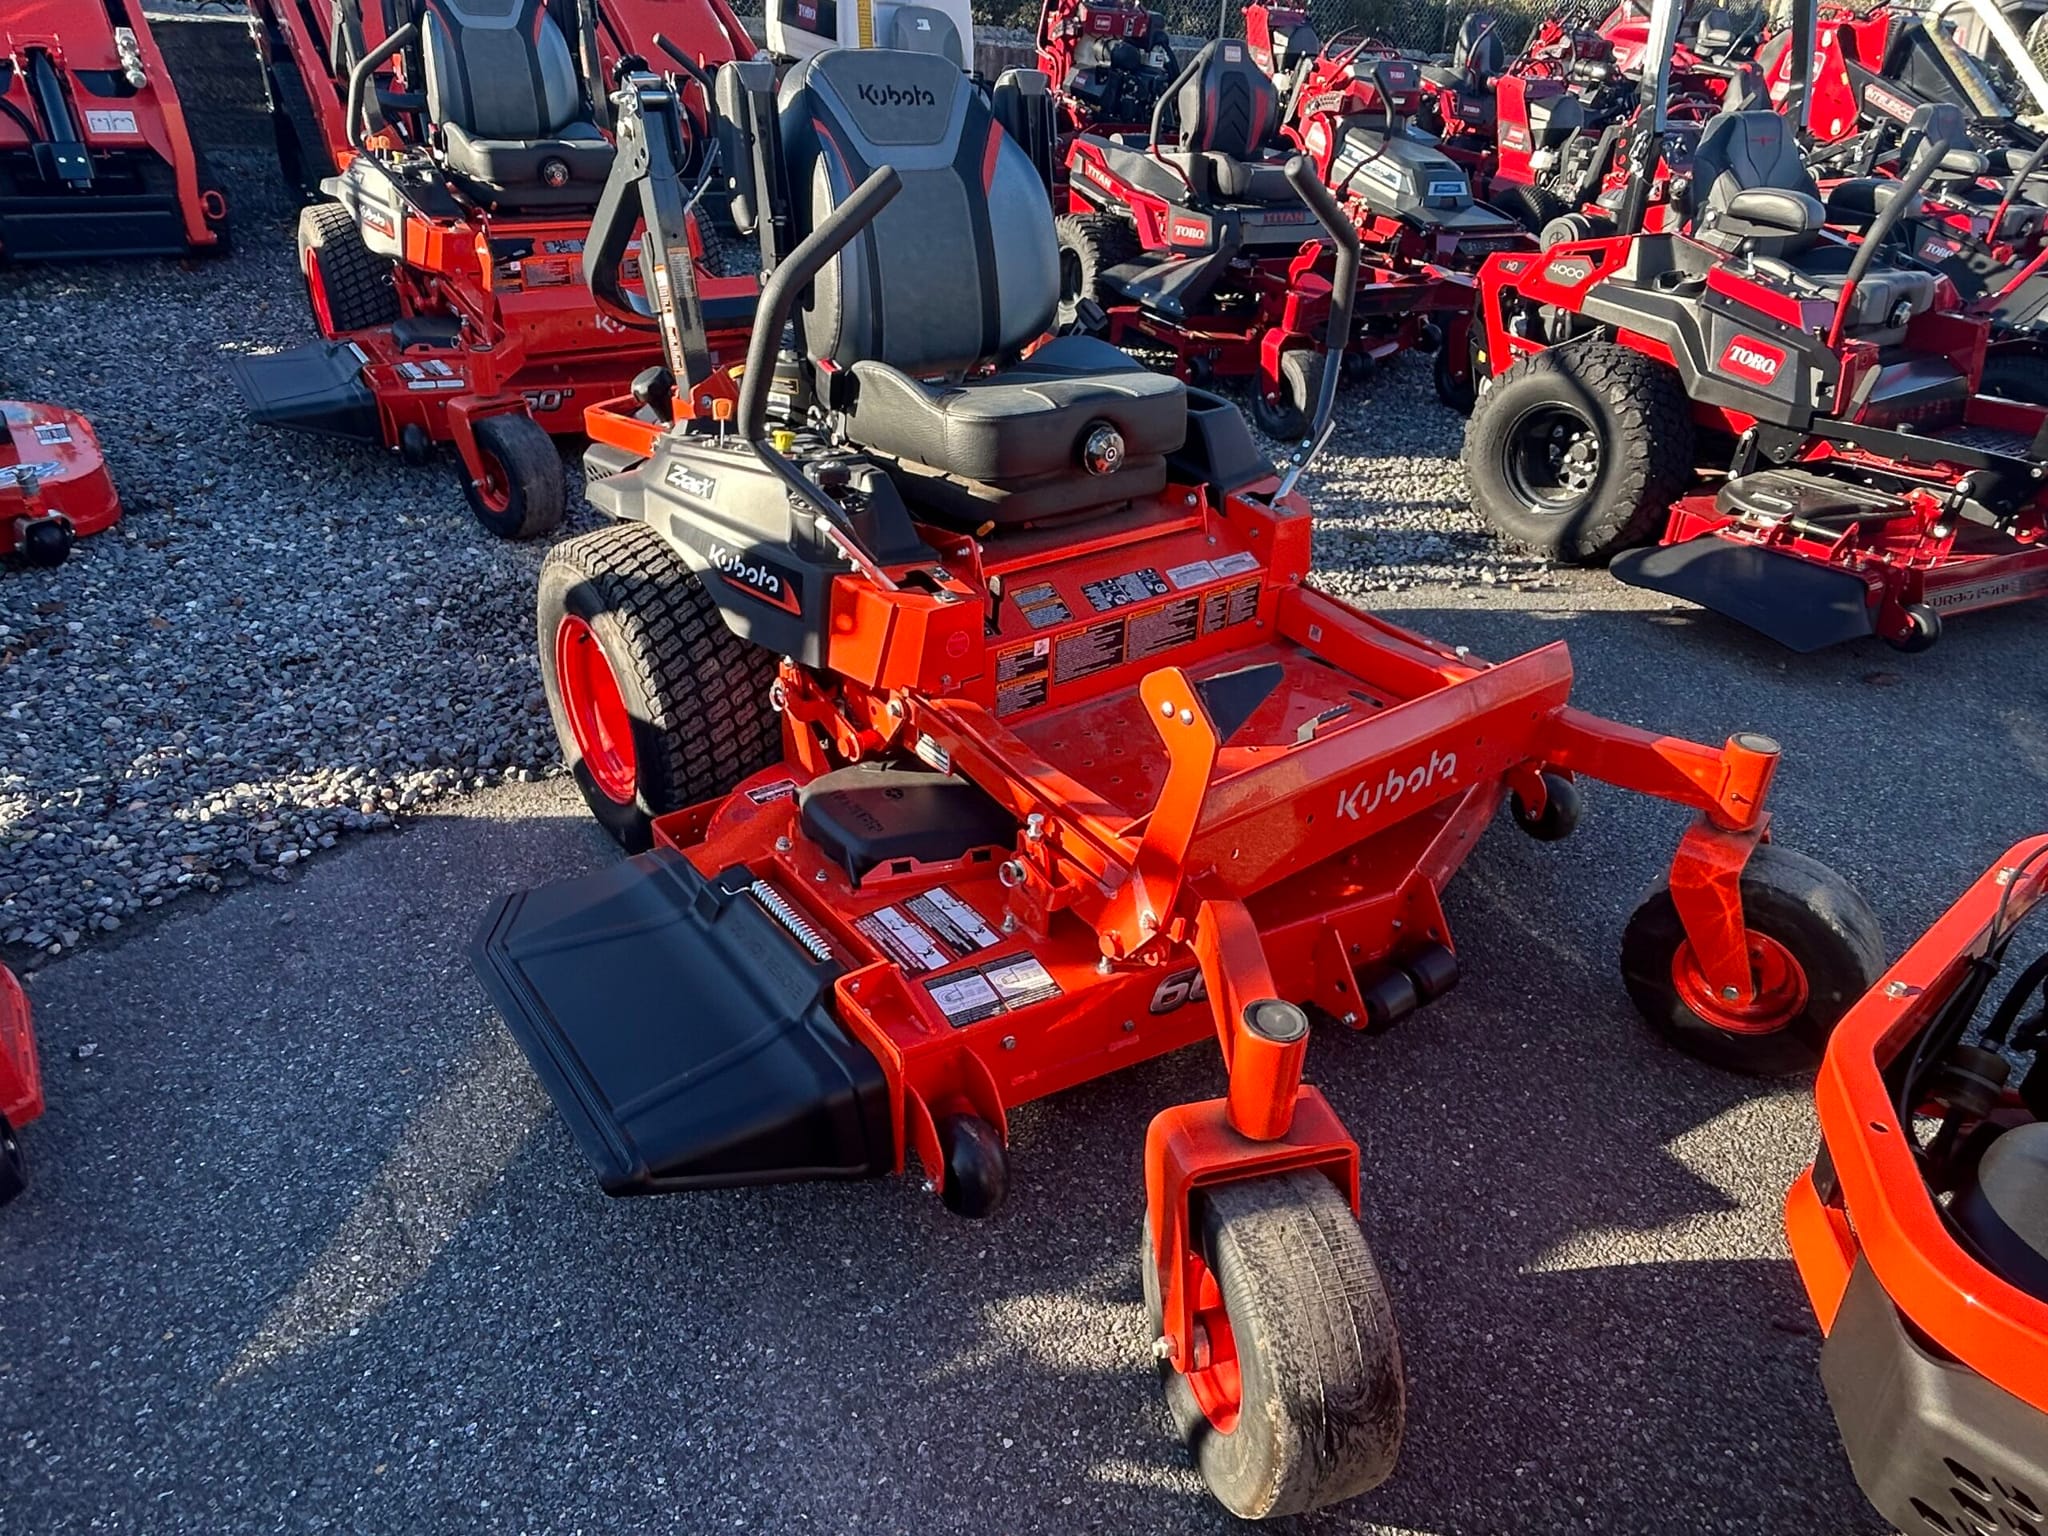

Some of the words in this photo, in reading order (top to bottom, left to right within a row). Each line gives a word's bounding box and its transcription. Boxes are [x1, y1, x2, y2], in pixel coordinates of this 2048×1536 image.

[858, 84, 935, 106] Kubota
[1087, 163, 1111, 189] TITAN
[1174, 224, 1206, 240] TORO
[1505, 261, 1519, 272] HD
[1549, 262, 1585, 280] 4000
[1729, 345, 1776, 375] TORO
[708, 544, 780, 594] Kubota
[1335, 749, 1458, 821] Kubota
